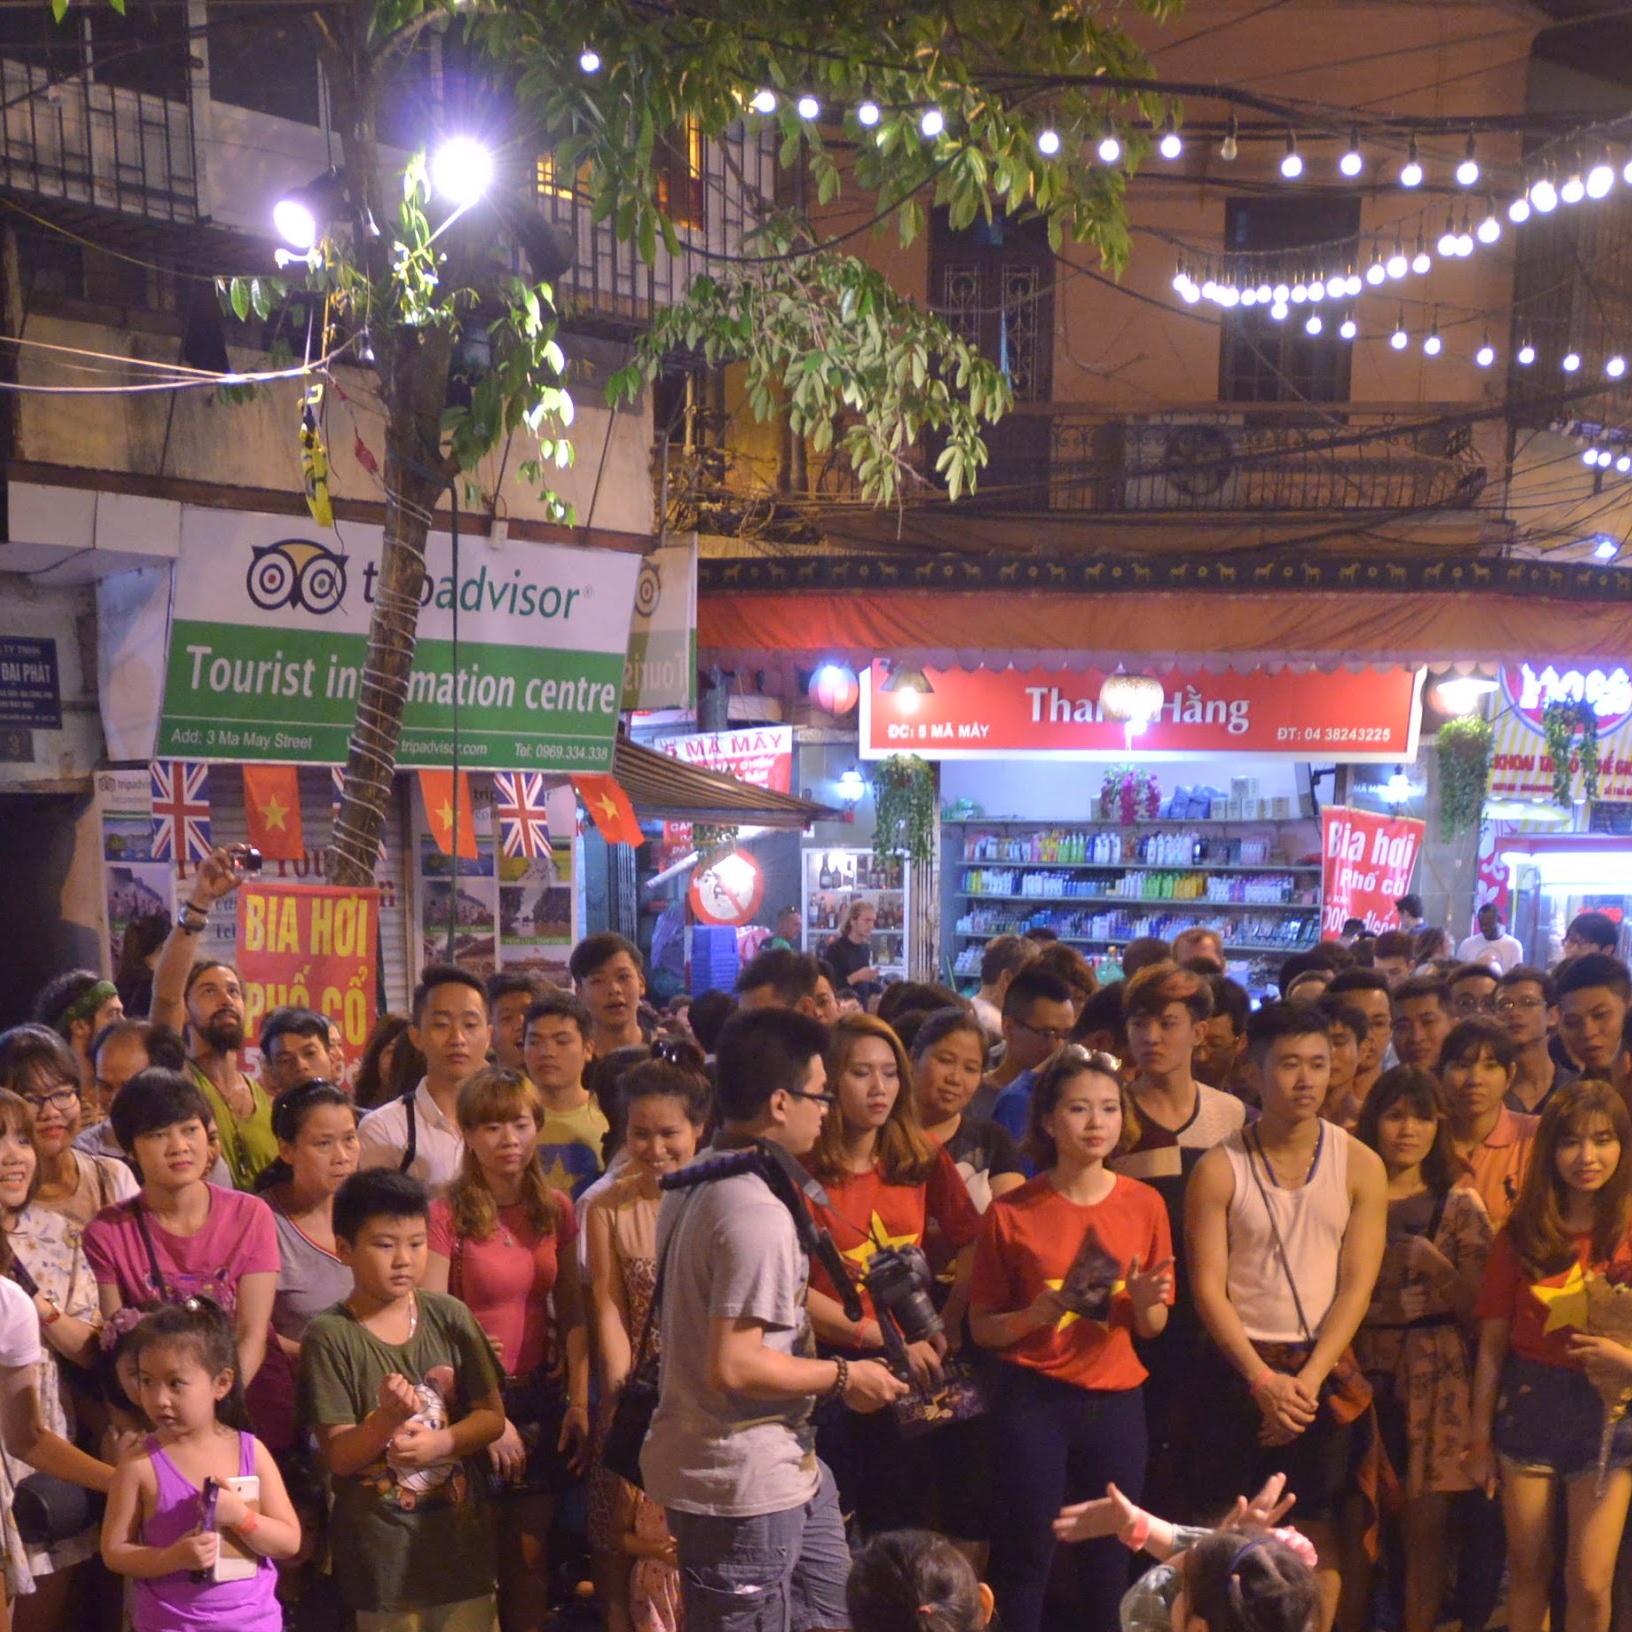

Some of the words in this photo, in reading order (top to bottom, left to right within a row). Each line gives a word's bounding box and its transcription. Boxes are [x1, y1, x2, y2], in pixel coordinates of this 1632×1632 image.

[363, 561, 580, 619] tadvisor
[187, 645, 315, 698] Tourist
[327, 654, 515, 707] inmation
[525, 676, 616, 713] centre
[171, 728, 203, 745] Add:
[207, 731, 216, 745] 3
[219, 731, 240, 746] Ma
[244, 732, 270, 750] May
[274, 733, 312, 749] Street
[514, 742, 533, 757] Tel:
[535, 742, 608, 761] 0969.334.338
[731, 732, 782, 753] MÂY
[1305, 727, 1321, 741] 04
[1325, 727, 1391, 741] 38243225
[1328, 821, 1366, 863] Bia
[1371, 828, 1416, 869] hơi
[1340, 868, 1380, 892] Phố
[245, 894, 300, 953] BIA
[311, 894, 368, 957] HƠI
